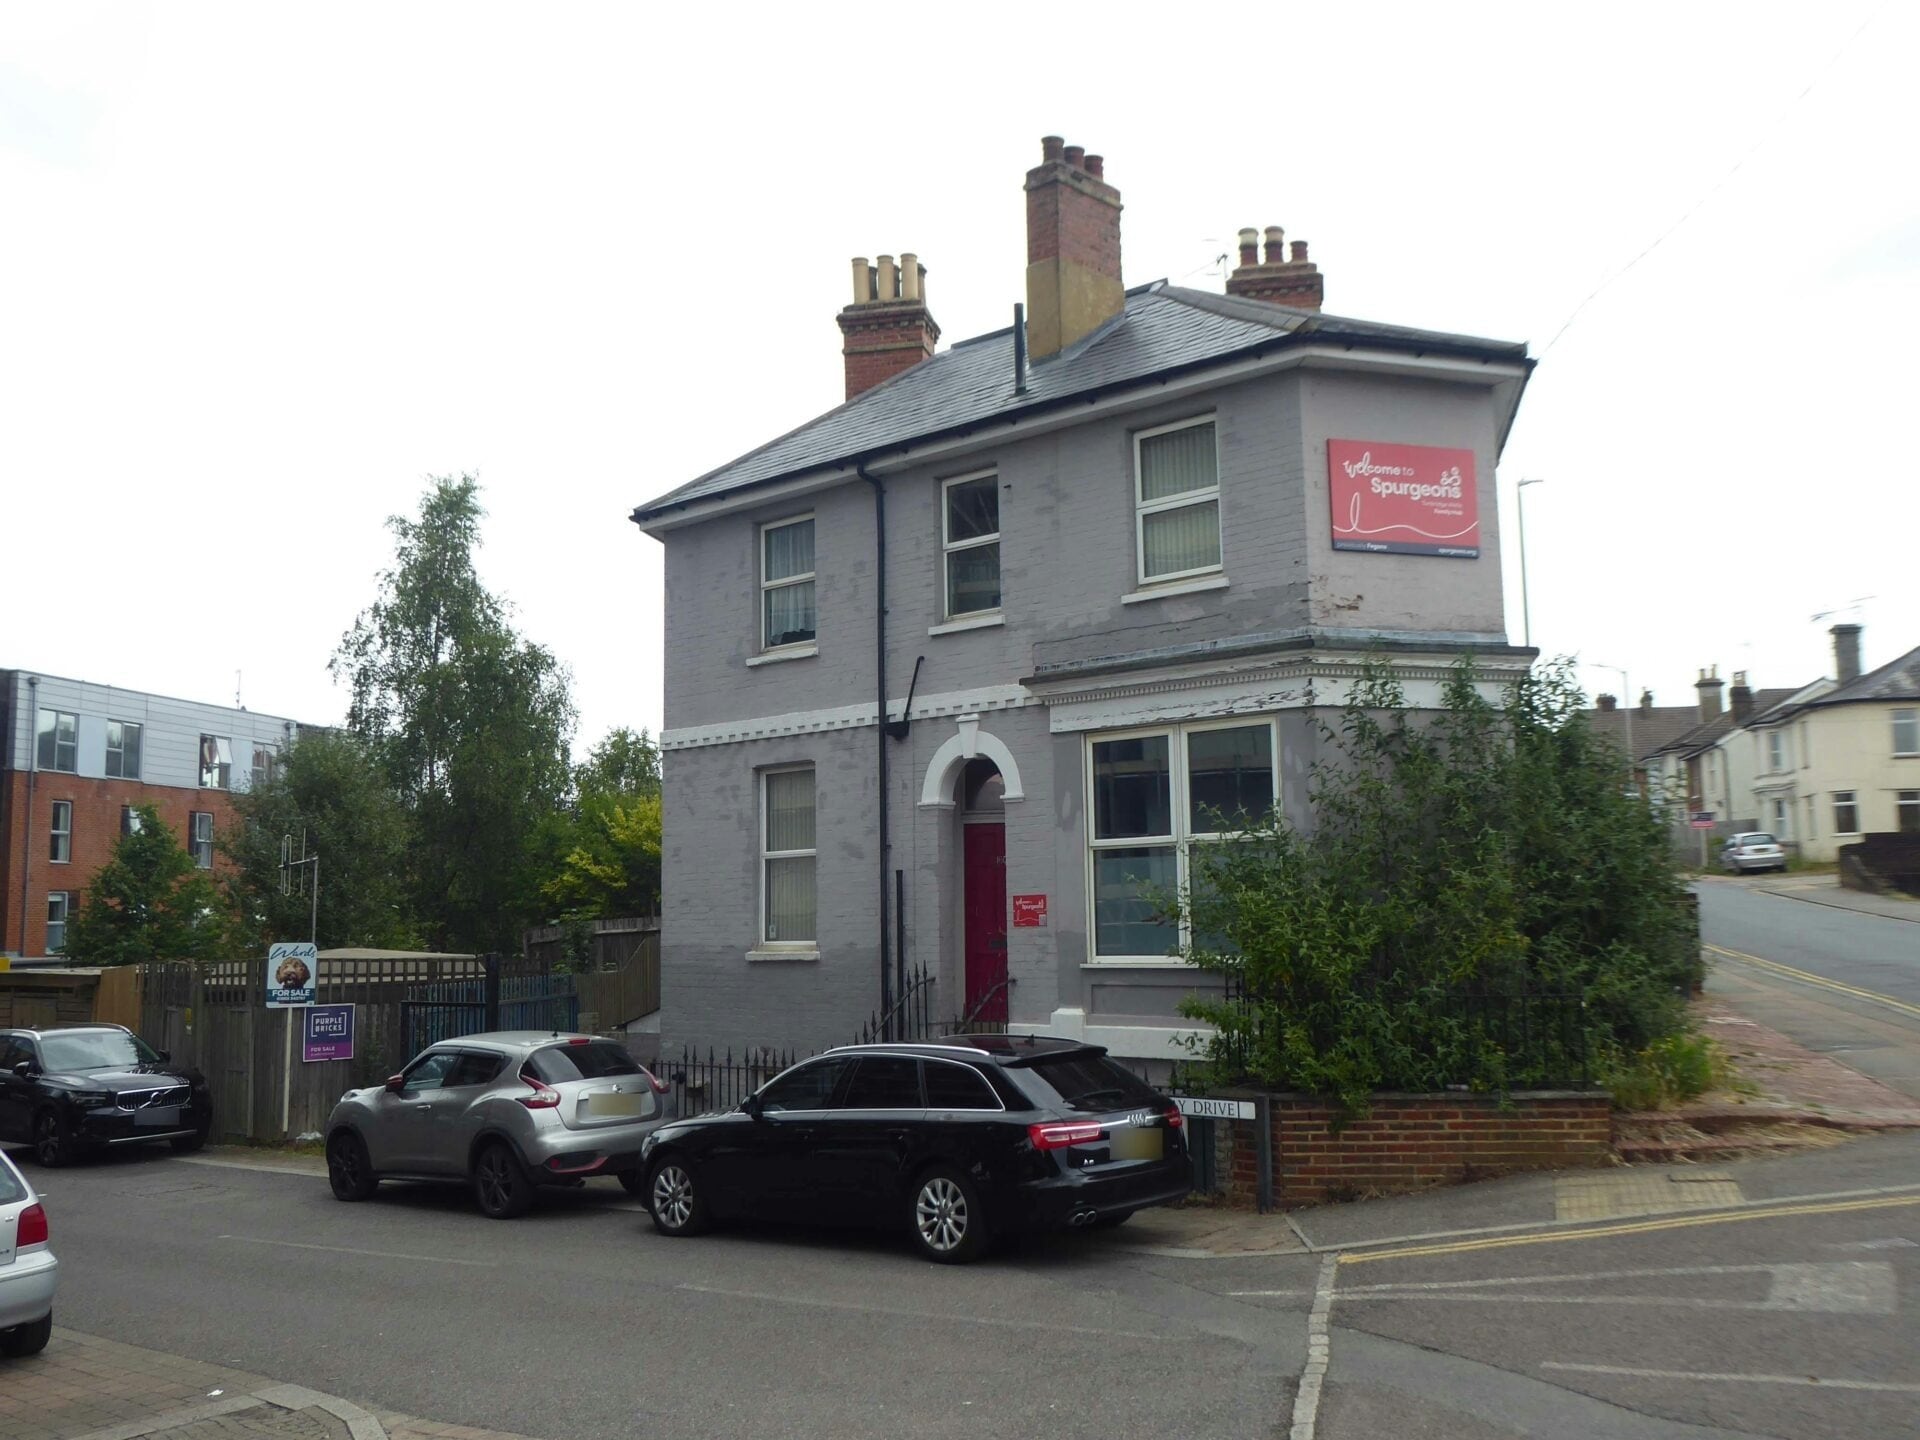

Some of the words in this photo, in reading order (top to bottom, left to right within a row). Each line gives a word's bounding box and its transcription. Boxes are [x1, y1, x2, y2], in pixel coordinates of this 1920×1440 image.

[1343, 451, 1400, 478] welcome
[1402, 467, 1414, 476] to
[1371, 477, 1461, 500] Spurgeons
[270, 945, 316, 960] Wards
[272, 989, 290, 997] FOR
[290, 989, 311, 997] SALE
[315, 1016, 342, 1025] PURPLE
[315, 1024, 342, 1032] BRICKS
[1193, 1100, 1235, 1116] DRIVE
